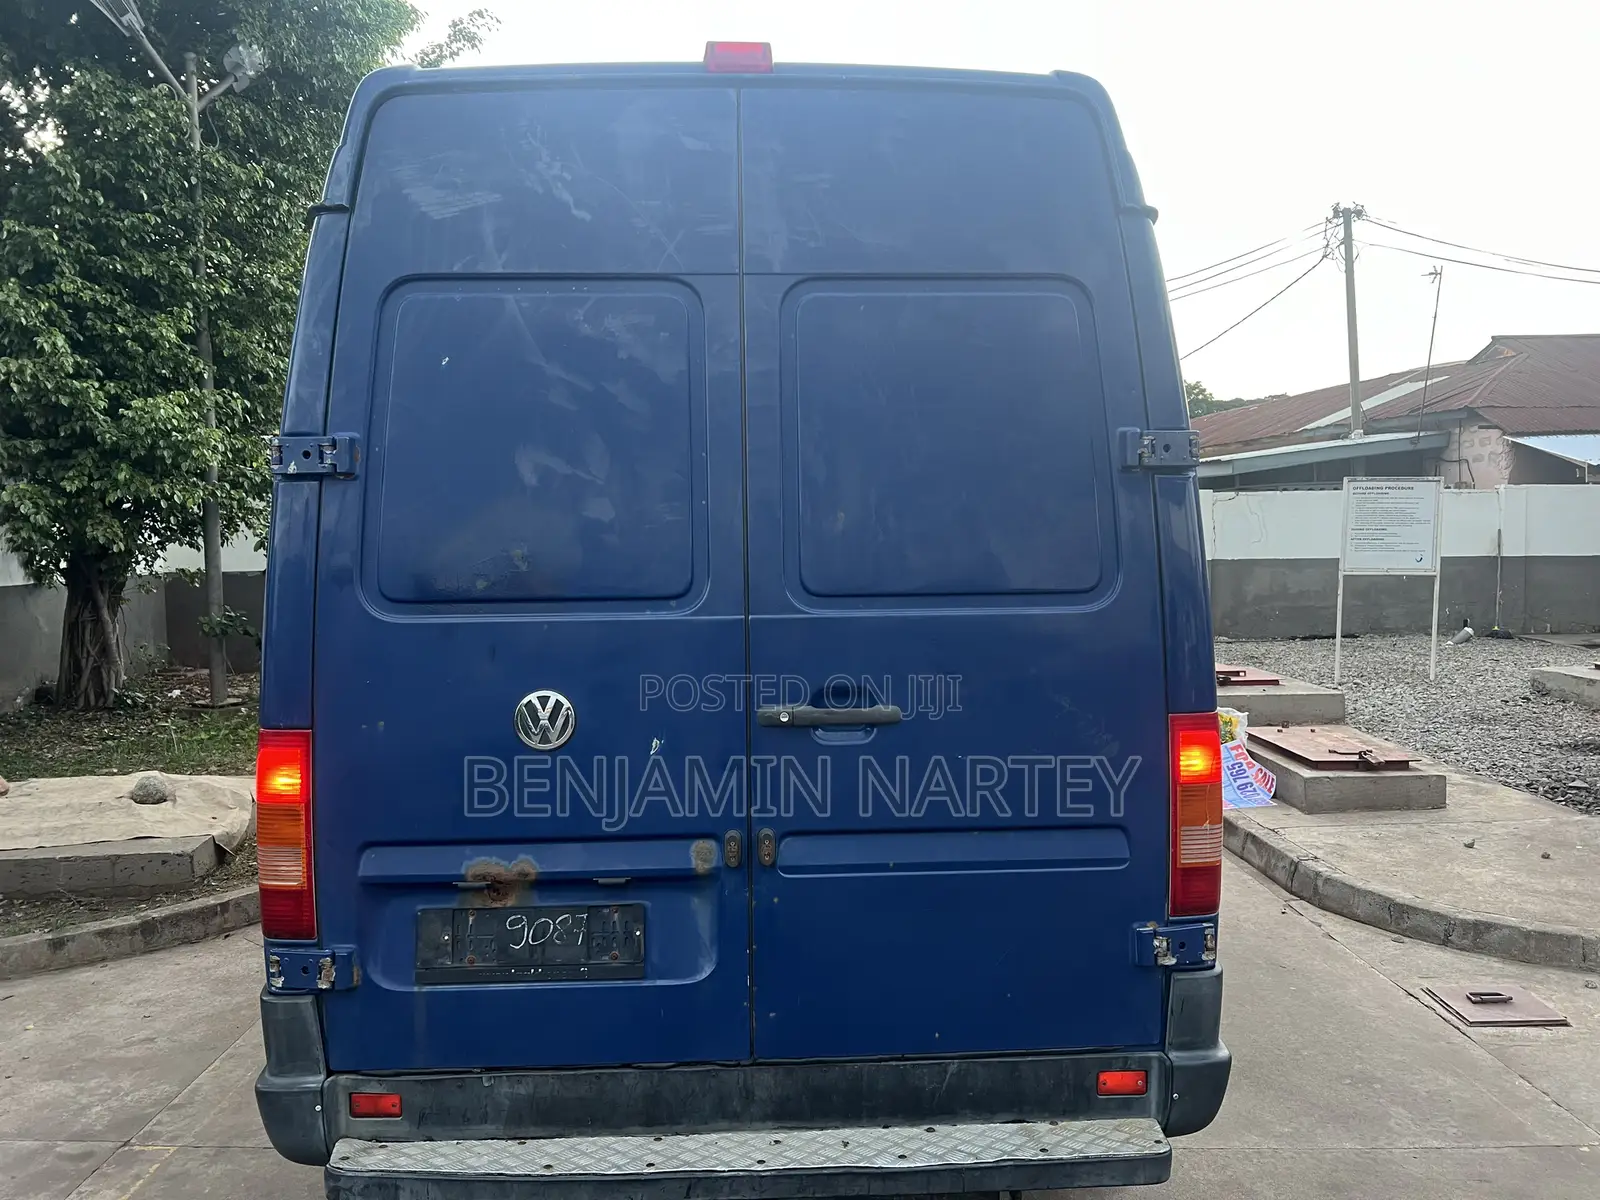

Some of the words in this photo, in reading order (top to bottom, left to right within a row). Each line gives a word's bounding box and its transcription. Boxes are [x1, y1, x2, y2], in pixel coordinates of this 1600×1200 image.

[516, 690, 575, 749] VW
[1251, 768, 1275, 793] SALE
[505, 913, 588, 950] 9087
